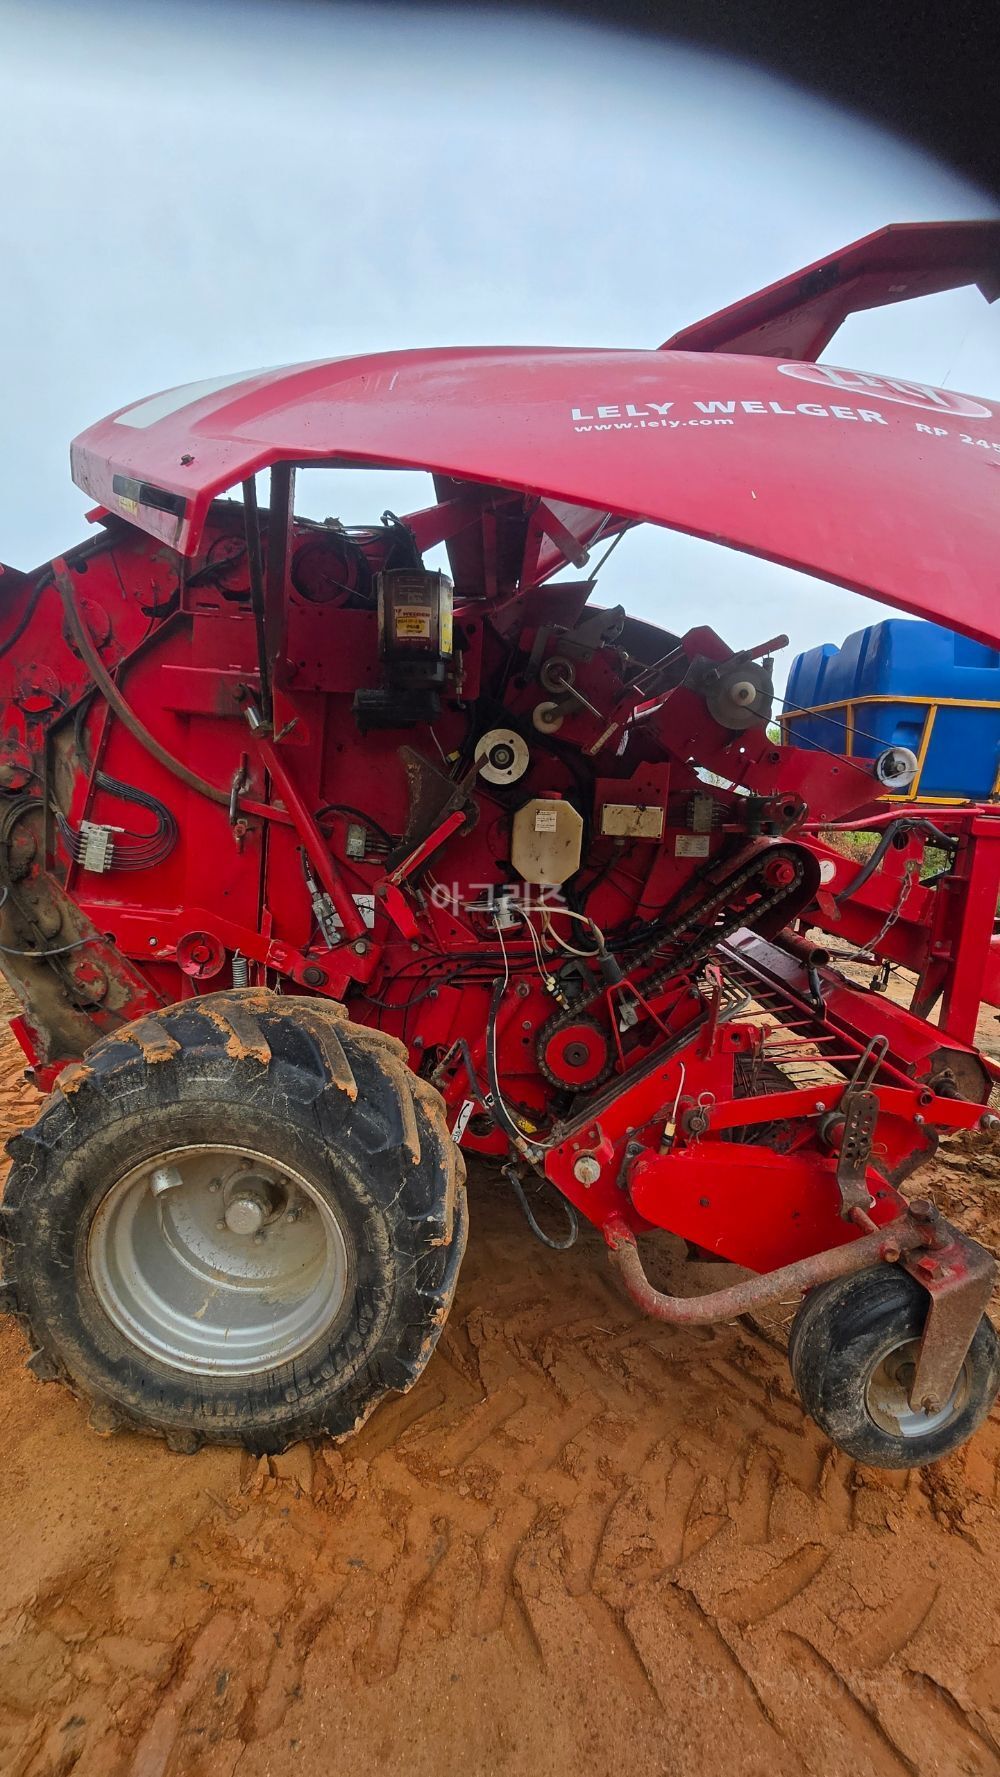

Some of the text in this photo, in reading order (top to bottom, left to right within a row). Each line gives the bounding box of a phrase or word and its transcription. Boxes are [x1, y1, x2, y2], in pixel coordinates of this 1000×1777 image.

[806, 363, 952, 408] LELY
[571, 400, 888, 425] LELY WELGER
[574, 415, 735, 433] www.lely.com
[915, 423, 948, 437] RP
